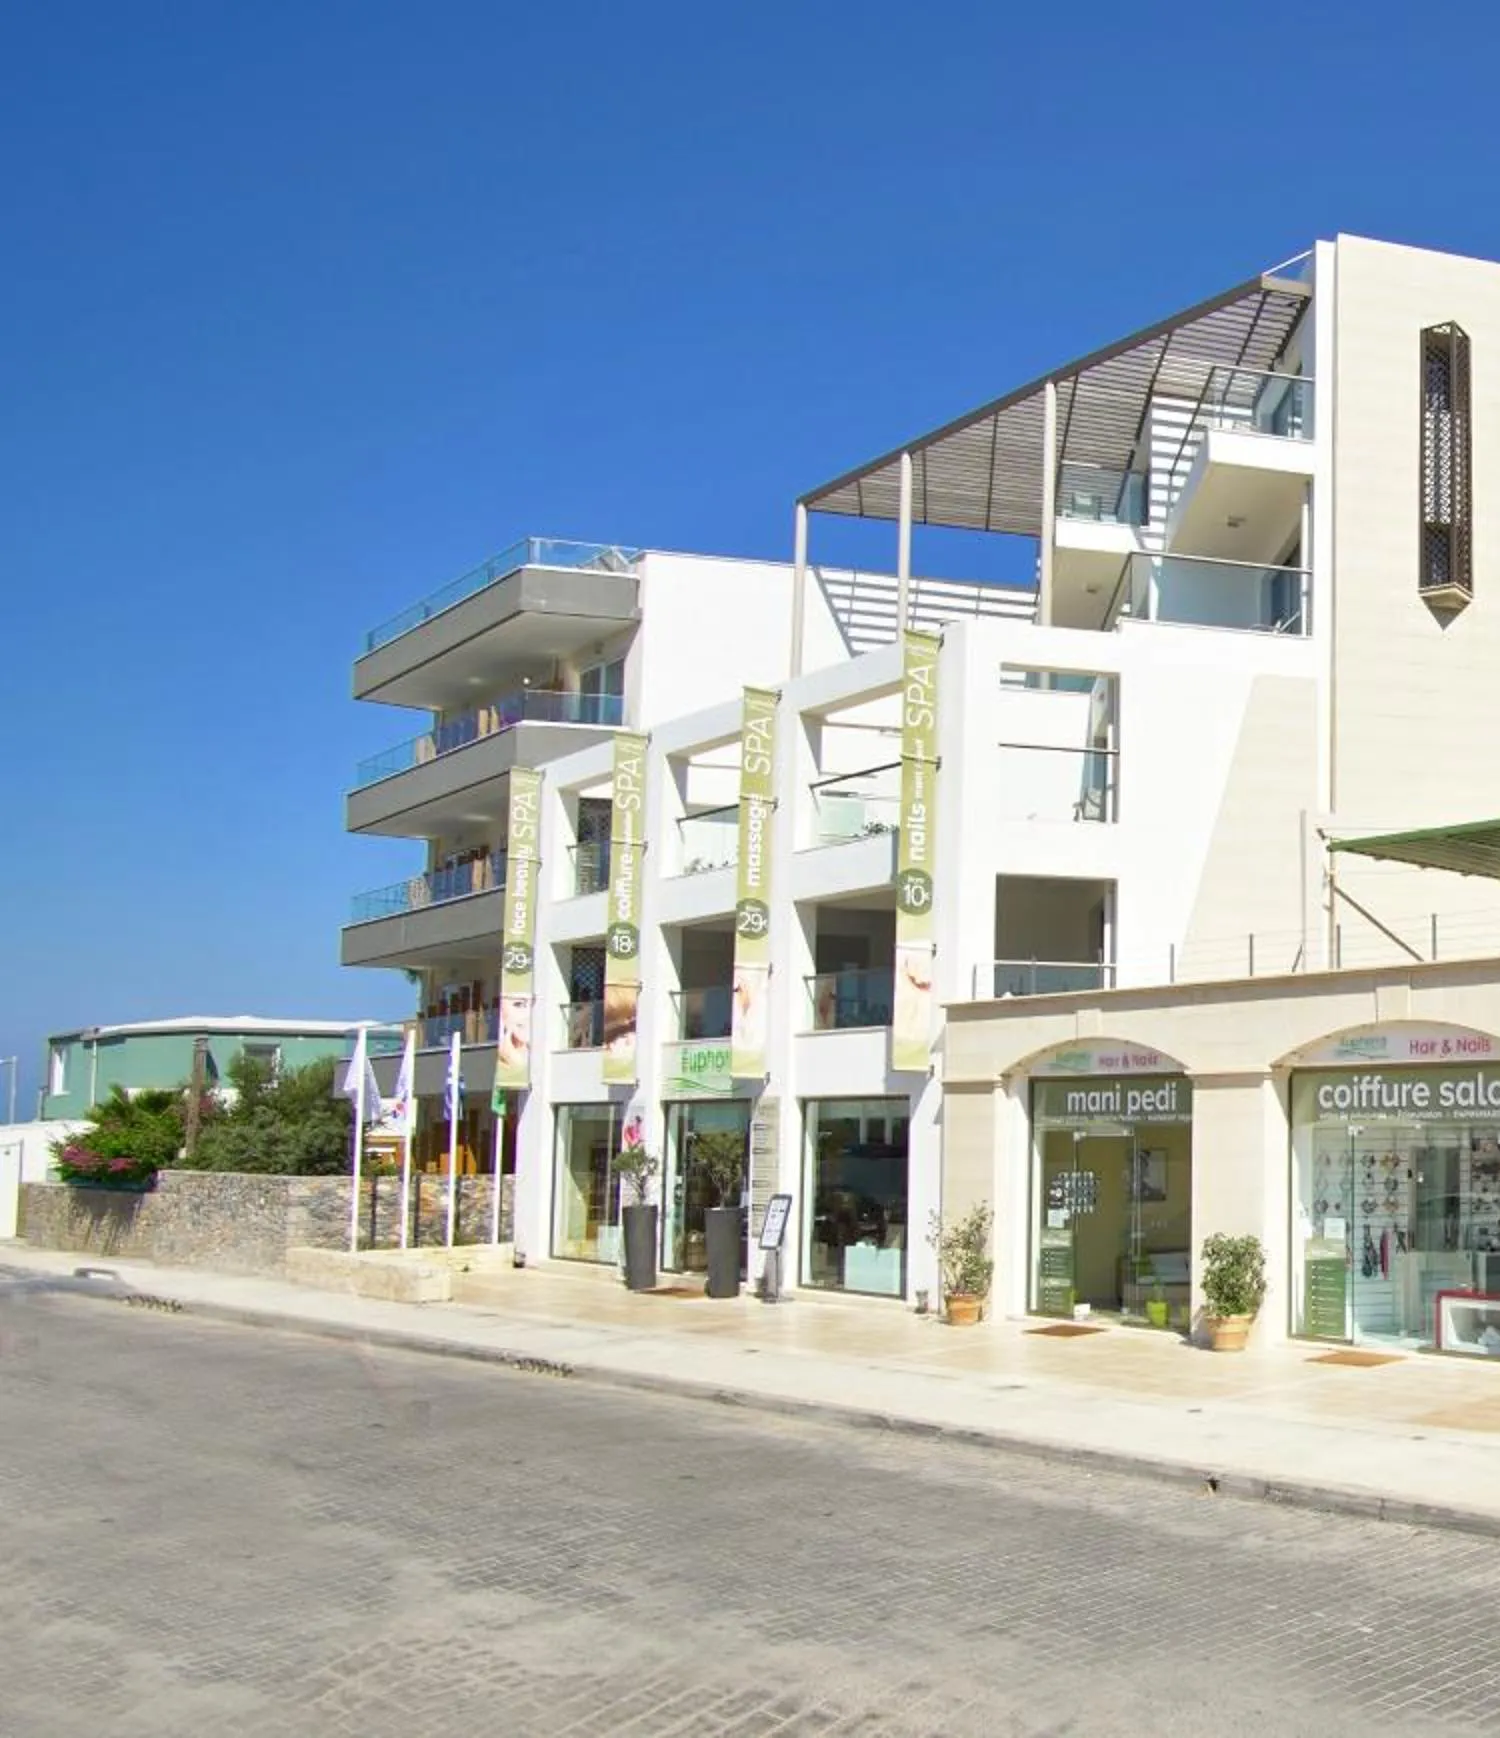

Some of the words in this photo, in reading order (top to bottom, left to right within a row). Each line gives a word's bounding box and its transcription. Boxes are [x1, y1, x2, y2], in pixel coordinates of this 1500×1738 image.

[905, 666, 934, 729] SPA
[744, 716, 772, 776] SPA
[614, 756, 641, 811] SPA
[511, 792, 538, 840] SPA
[747, 793, 767, 887] massage
[906, 804, 927, 862] nails
[615, 853, 634, 920] coiffure
[1409, 1038, 1436, 1055] Hair
[1441, 1038, 1451, 1055] &
[1456, 1035, 1492, 1053] Nails
[1067, 1081, 1121, 1113] mani
[1127, 1080, 1177, 1116] pedi
[1318, 1075, 1431, 1109] coiffure
